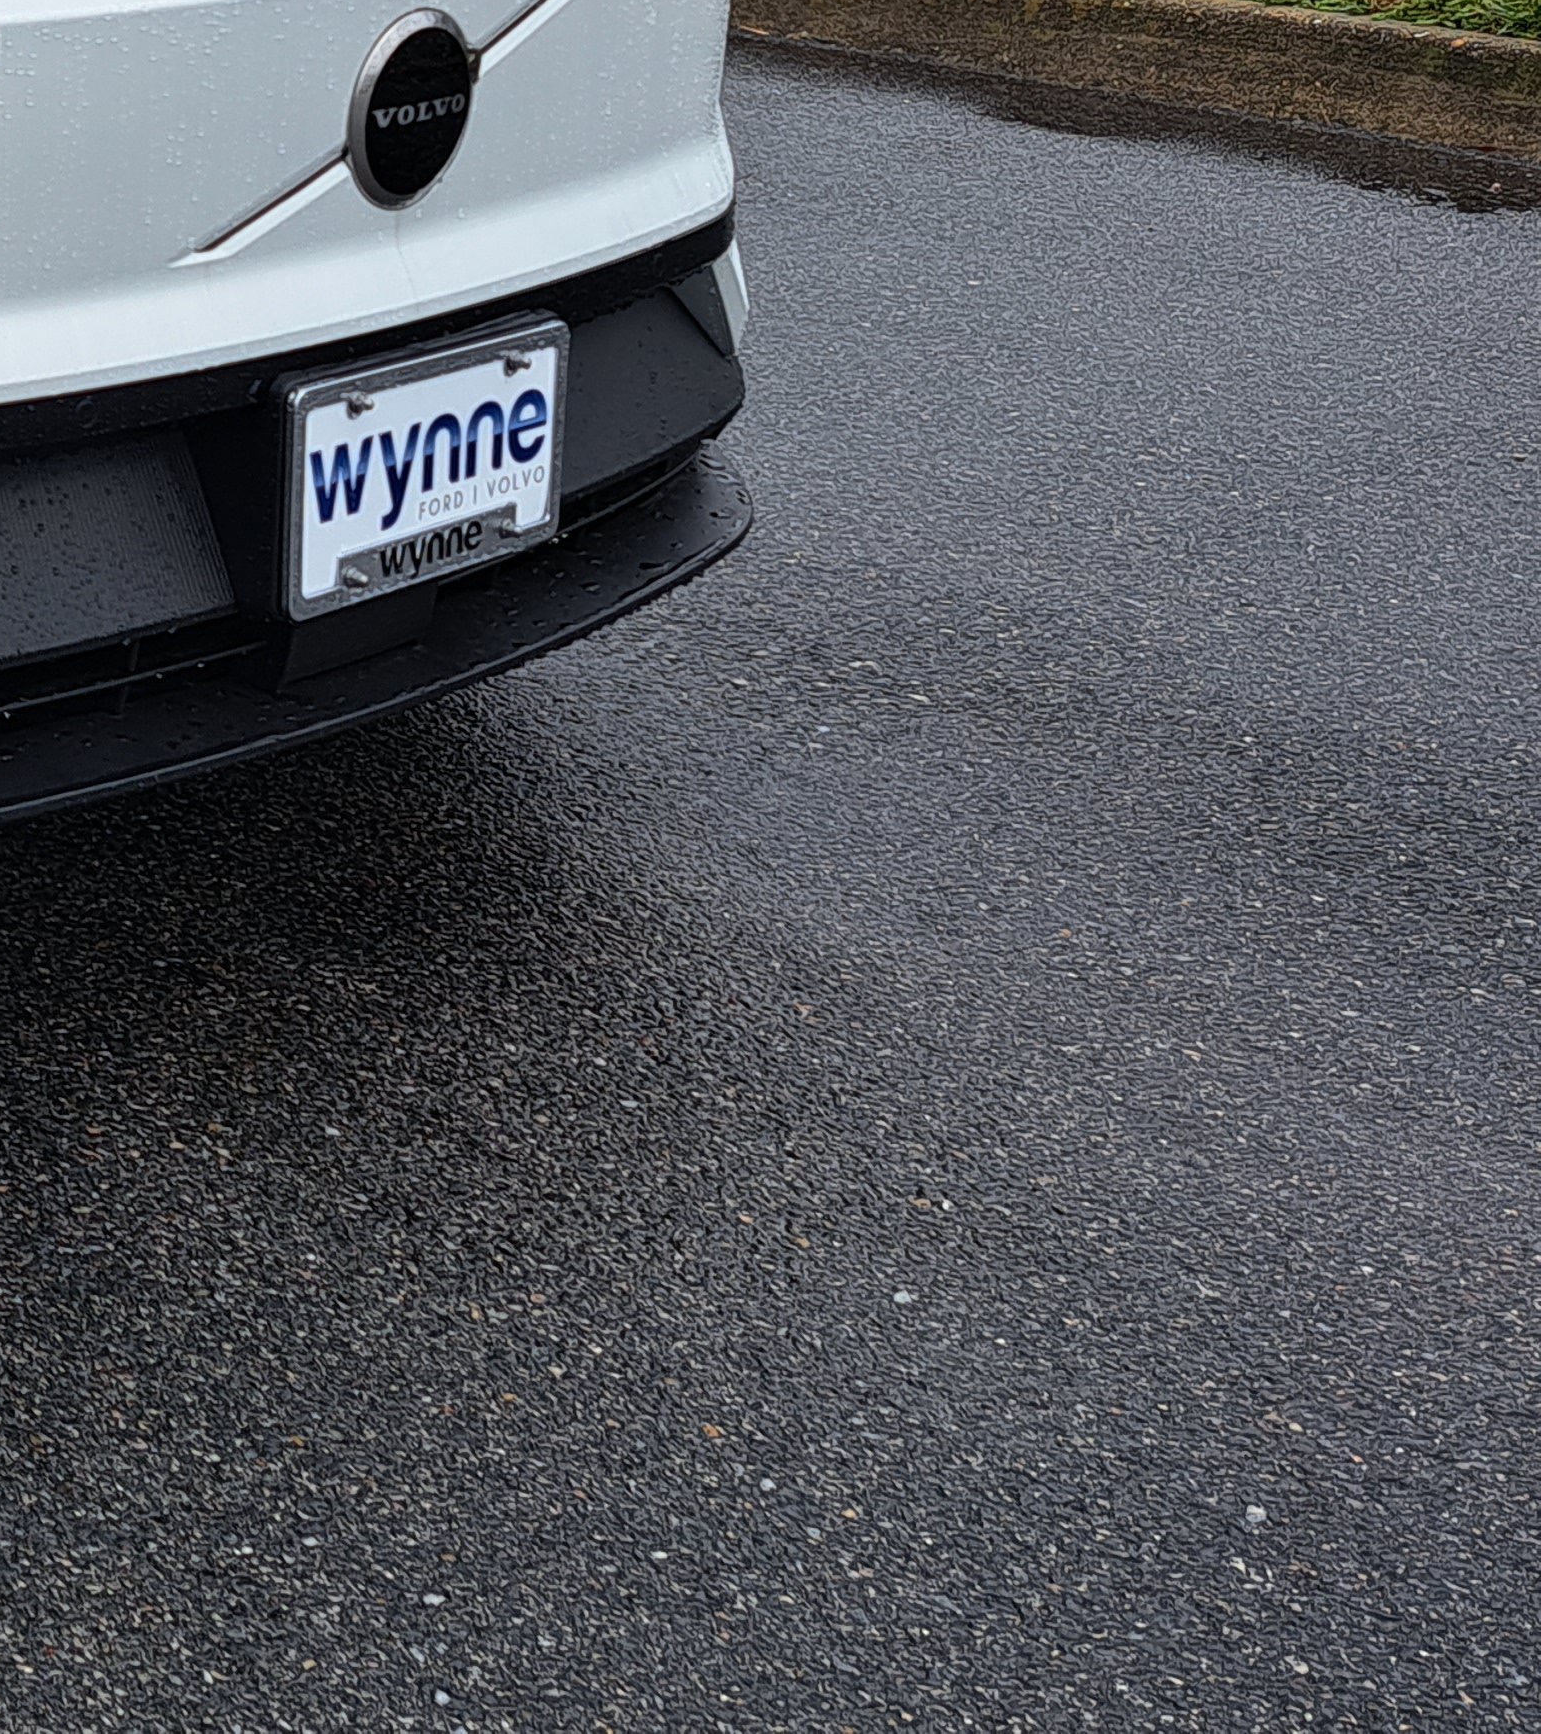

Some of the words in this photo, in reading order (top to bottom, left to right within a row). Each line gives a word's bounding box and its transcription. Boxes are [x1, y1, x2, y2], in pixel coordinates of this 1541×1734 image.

[372, 93, 466, 129] VOLVO
[309, 388, 548, 532] wynne
[418, 490, 464, 522] FORD
[487, 465, 546, 499] VOLVO
[379, 519, 484, 579] wynne
